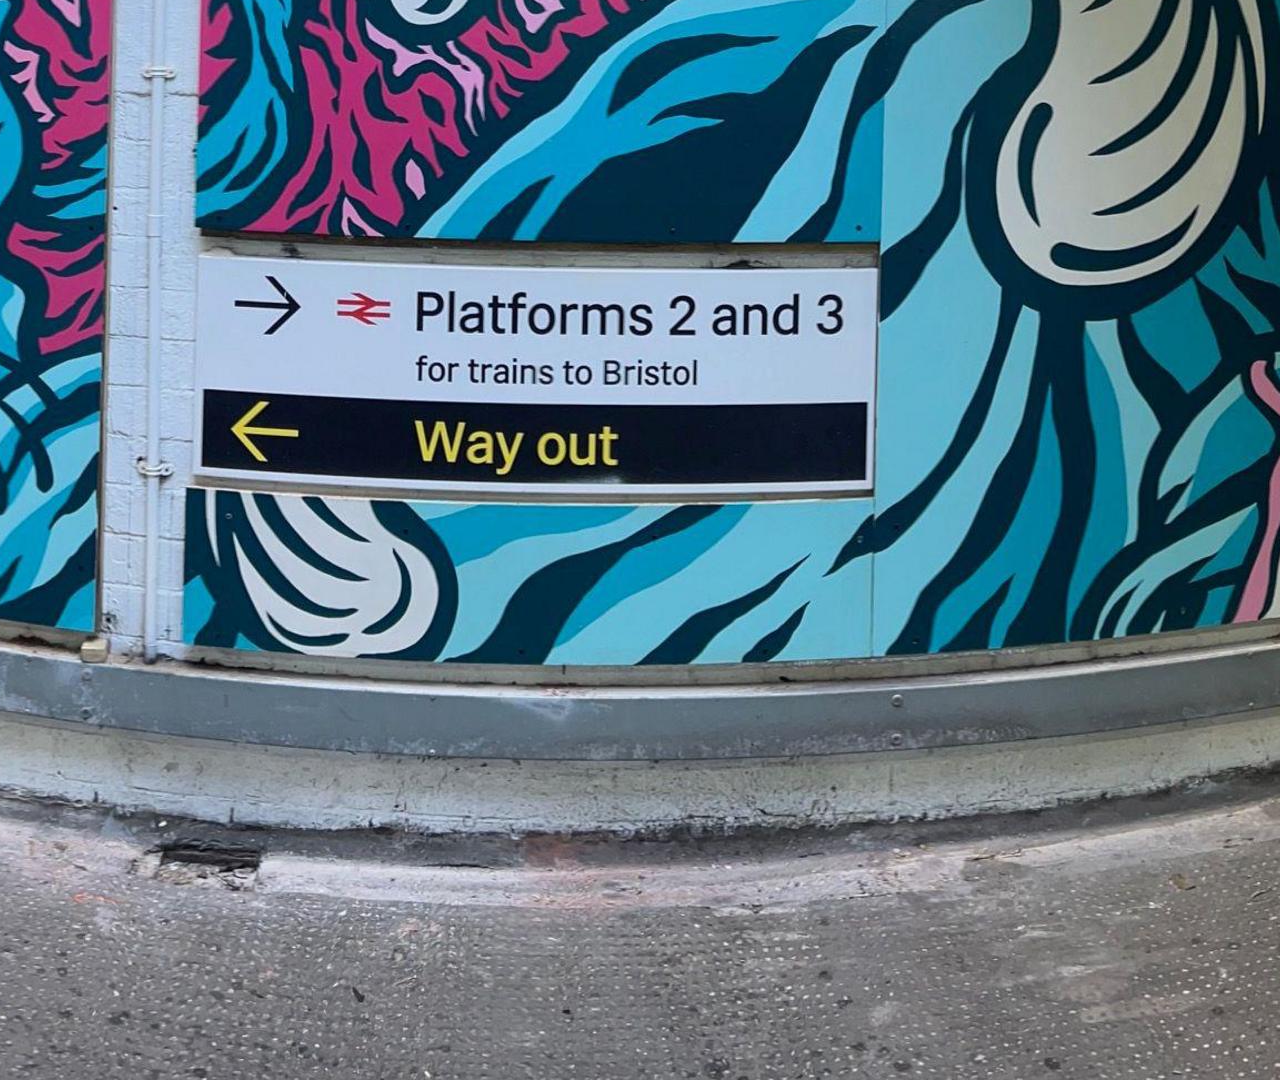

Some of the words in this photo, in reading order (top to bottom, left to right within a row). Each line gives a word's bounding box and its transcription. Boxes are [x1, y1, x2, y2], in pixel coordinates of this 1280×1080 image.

[416, 291, 654, 337] Platforms
[669, 294, 697, 336] 2
[711, 293, 800, 336] and
[816, 294, 844, 335] 3
[416, 355, 459, 383] for
[468, 358, 554, 385] trains
[563, 360, 593, 386] to
[602, 359, 698, 386] Bristol
[414, 419, 524, 475] Way
[537, 426, 619, 466] out
